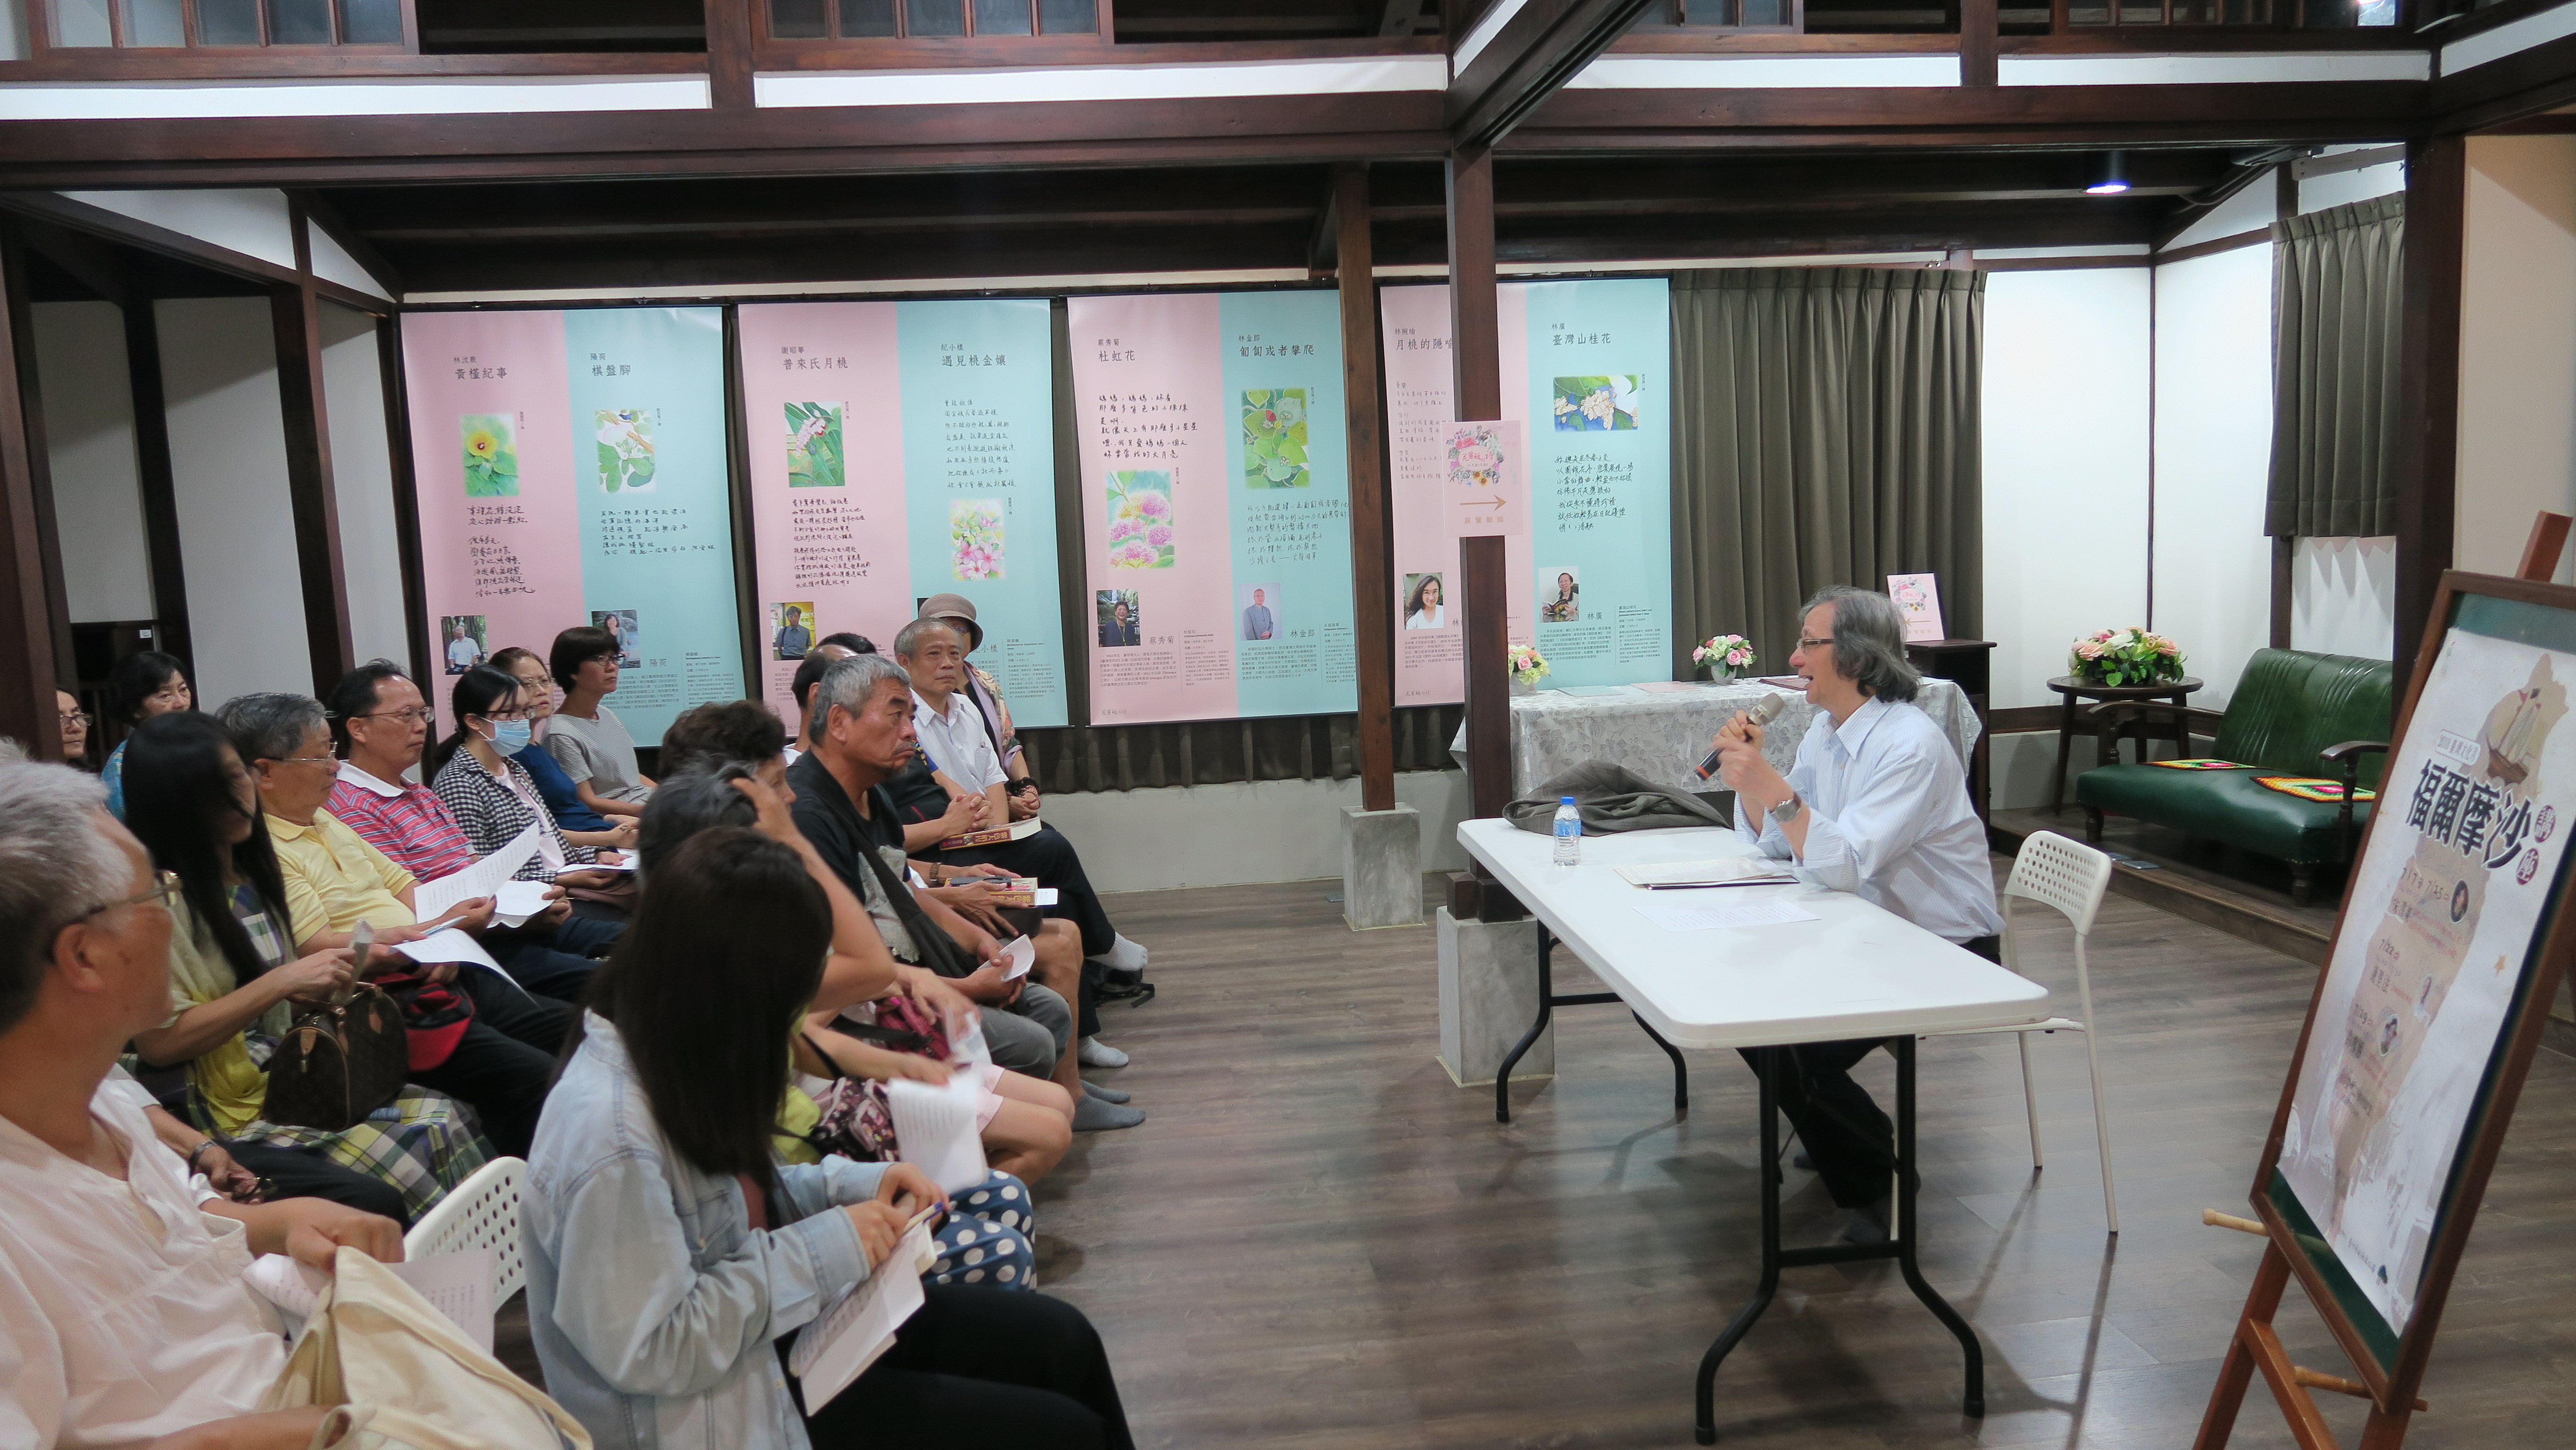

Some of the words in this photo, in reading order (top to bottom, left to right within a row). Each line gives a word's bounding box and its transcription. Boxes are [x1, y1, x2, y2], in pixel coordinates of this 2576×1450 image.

[1097, 338, 1120, 347] 蔡秀菊
[1238, 334, 1261, 343] 林金郎
[1552, 332, 1611, 346] 臺灣山桂花
[1098, 349, 1136, 362] 杜虹花
[1240, 343, 1315, 358] 匍匐或者攀爬
[942, 354, 1006, 367] 遇見桃金孃
[455, 366, 508, 381] 黃槿紀事
[591, 364, 632, 377] 棋盤腳
[1586, 612, 1603, 620] 林廣
[1290, 628, 1315, 638] 林金郎
[1149, 636, 1175, 645] 蔡秀菊
[2406, 759, 2532, 869] 福爾摩沙
